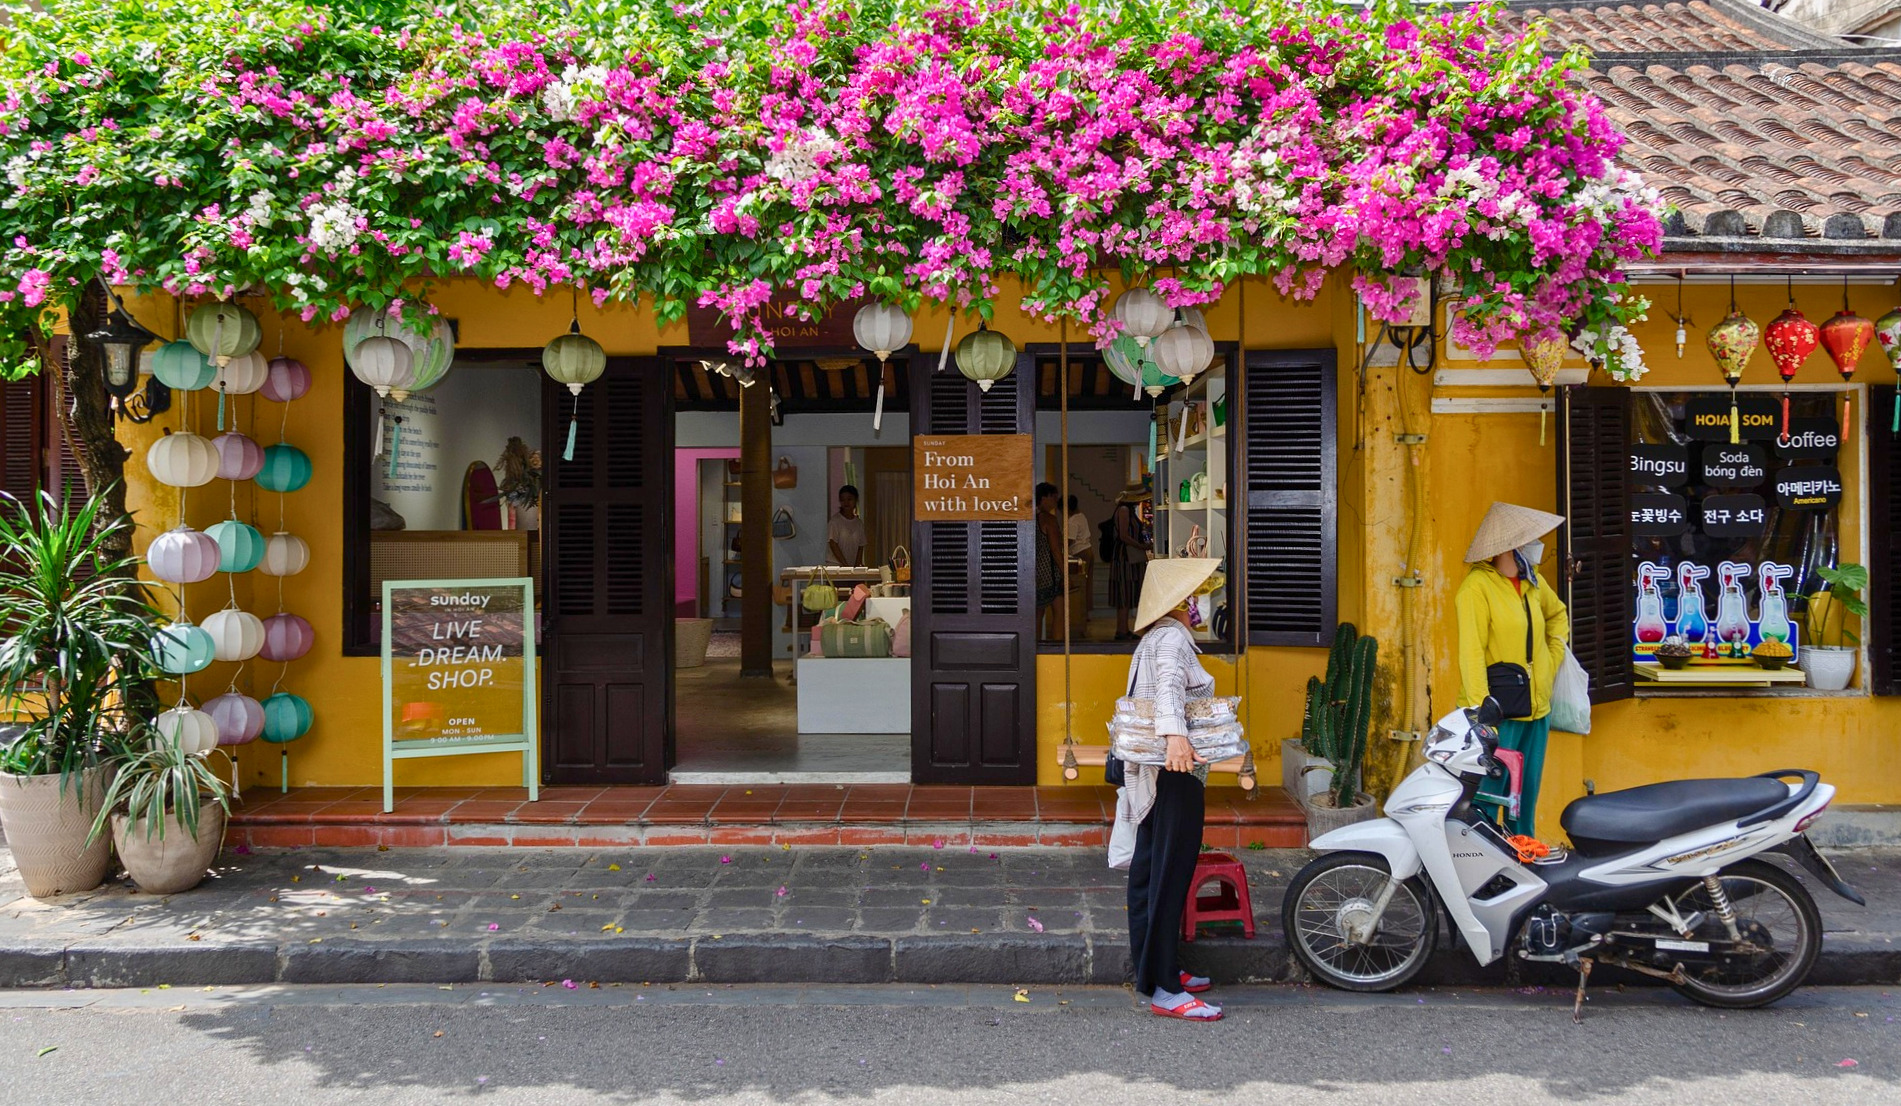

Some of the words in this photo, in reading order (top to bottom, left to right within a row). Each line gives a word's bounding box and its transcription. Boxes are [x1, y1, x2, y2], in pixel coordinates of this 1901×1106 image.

[744, 299, 839, 319] UNY
[800, 326, 819, 336] AN
[1742, 414, 1774, 426] SOM
[1776, 431, 1837, 448] Coffee
[924, 451, 974, 467] From
[1719, 451, 1750, 463] Soda
[1705, 465, 1736, 479] bóng
[1740, 465, 1763, 477] đèn
[924, 473, 957, 489] Hoi
[962, 473, 991, 489] An
[1777, 479, 1841, 496] 아메리카노
[924, 496, 967, 512] with
[973, 496, 1019, 512] love!
[1793, 496, 1827, 504] Americano
[1703, 509, 1731, 524] 전구
[1735, 508, 1764, 524] 소다
[430, 592, 491, 608] sunday
[433, 620, 482, 640] LIVE
[427, 668, 494, 690] SHOP.
[448, 717, 476, 726] OPEN
